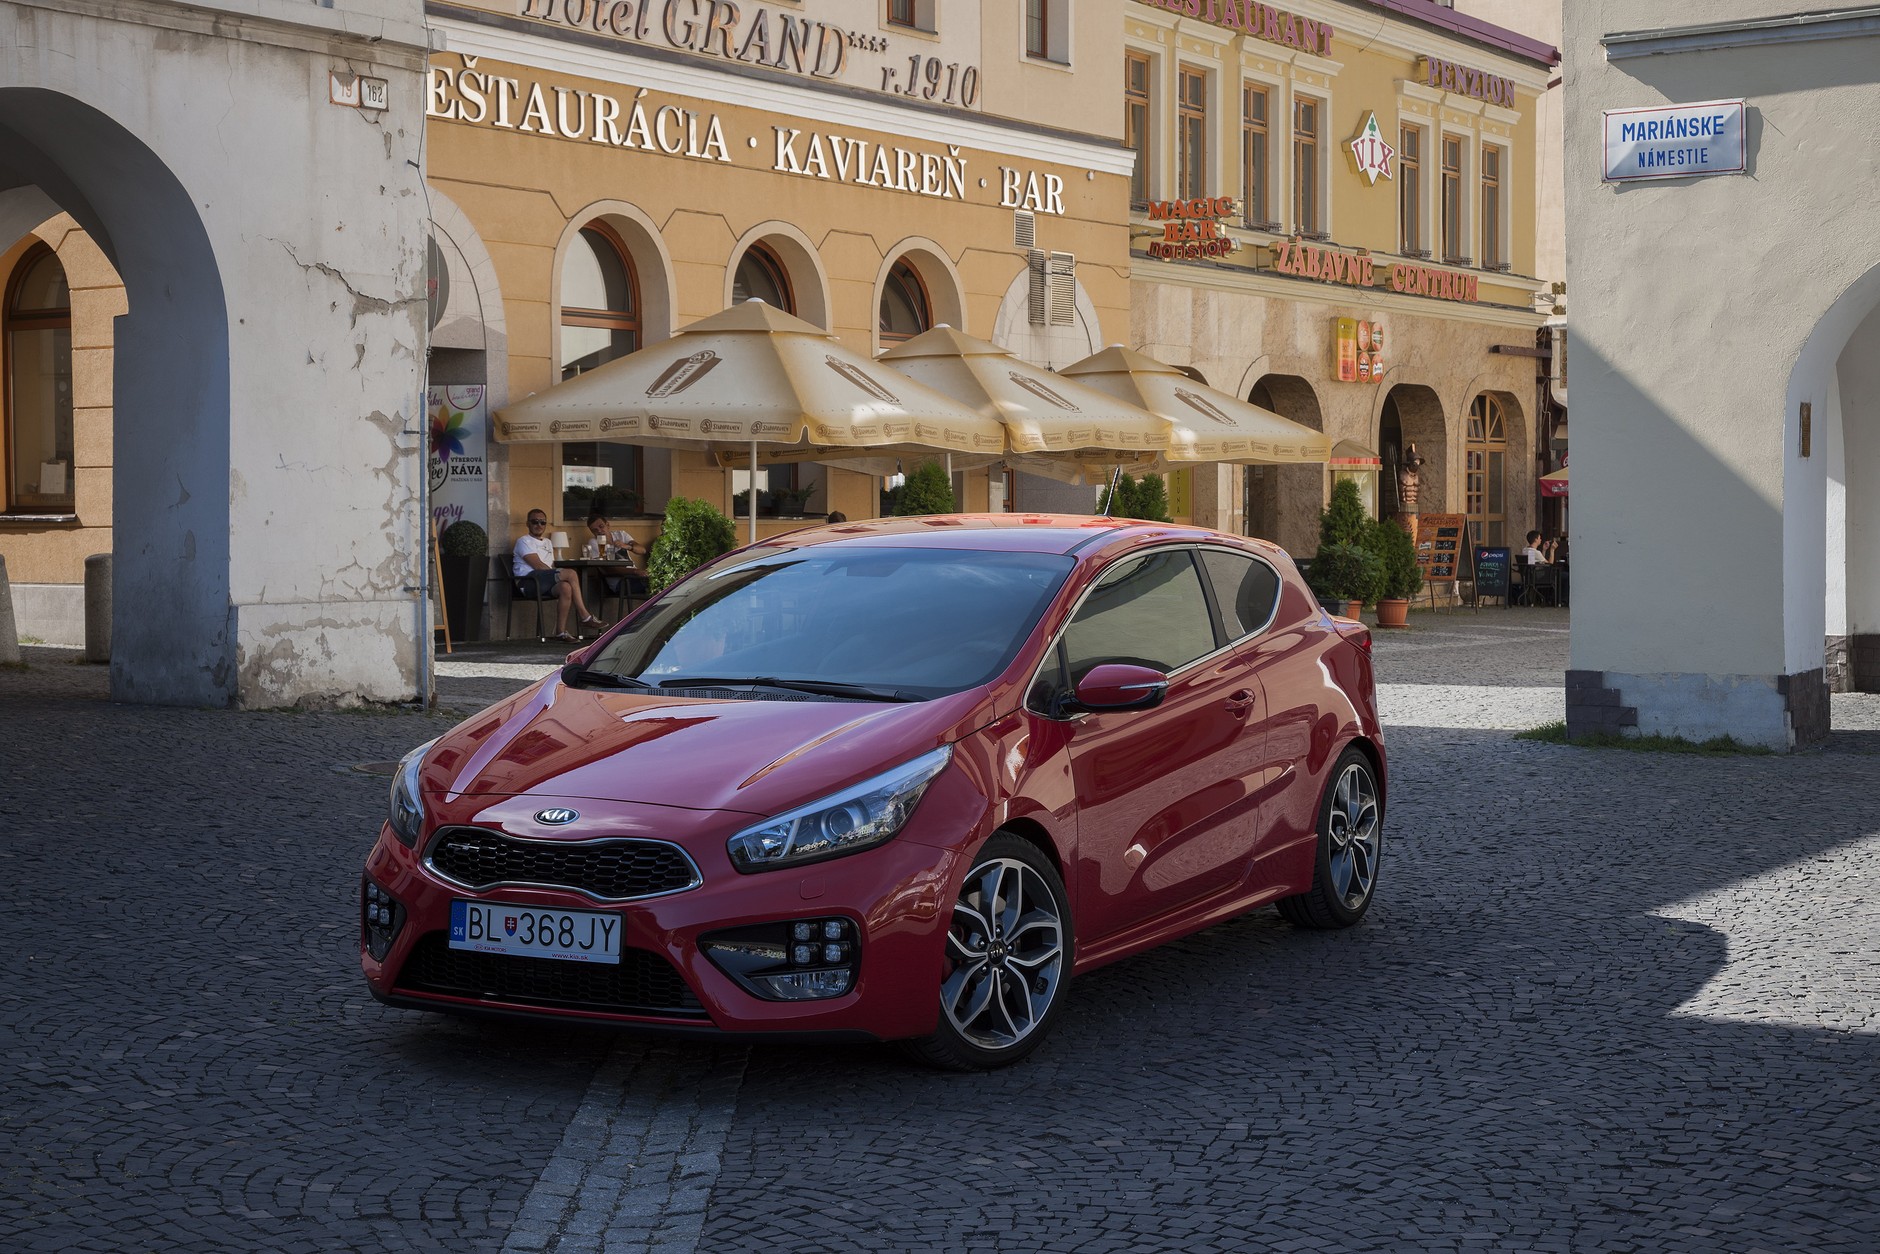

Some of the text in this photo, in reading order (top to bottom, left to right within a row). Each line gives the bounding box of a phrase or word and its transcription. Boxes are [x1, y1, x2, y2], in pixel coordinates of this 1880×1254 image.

[662, 0, 849, 79] GRAND
[1146, 0, 1335, 57] STAURANT
[341, 80, 353, 98] 19
[367, 84, 383, 103] 162
[881, 54, 980, 108] r.1910
[1426, 56, 1516, 108] PENZION
[426, 53, 1065, 215] EŠTAURÁCIA KAVIAREŇ BAR
[1622, 115, 1725, 142] MARIÁNSKE
[1353, 138, 1393, 177] VIX
[1638, 147, 1708, 168] NÁMESTIE
[1148, 196, 1233, 220] MAGIC
[1163, 220, 1218, 242] BAR
[1148, 237, 1232, 259] nonstop
[1277, 236, 1479, 302] ZÁBAVNÉ CENTRUM
[450, 463, 483, 475] KÁVA
[541, 809, 569, 821] KIA
[453, 907, 616, 951] SK BL 368JY
